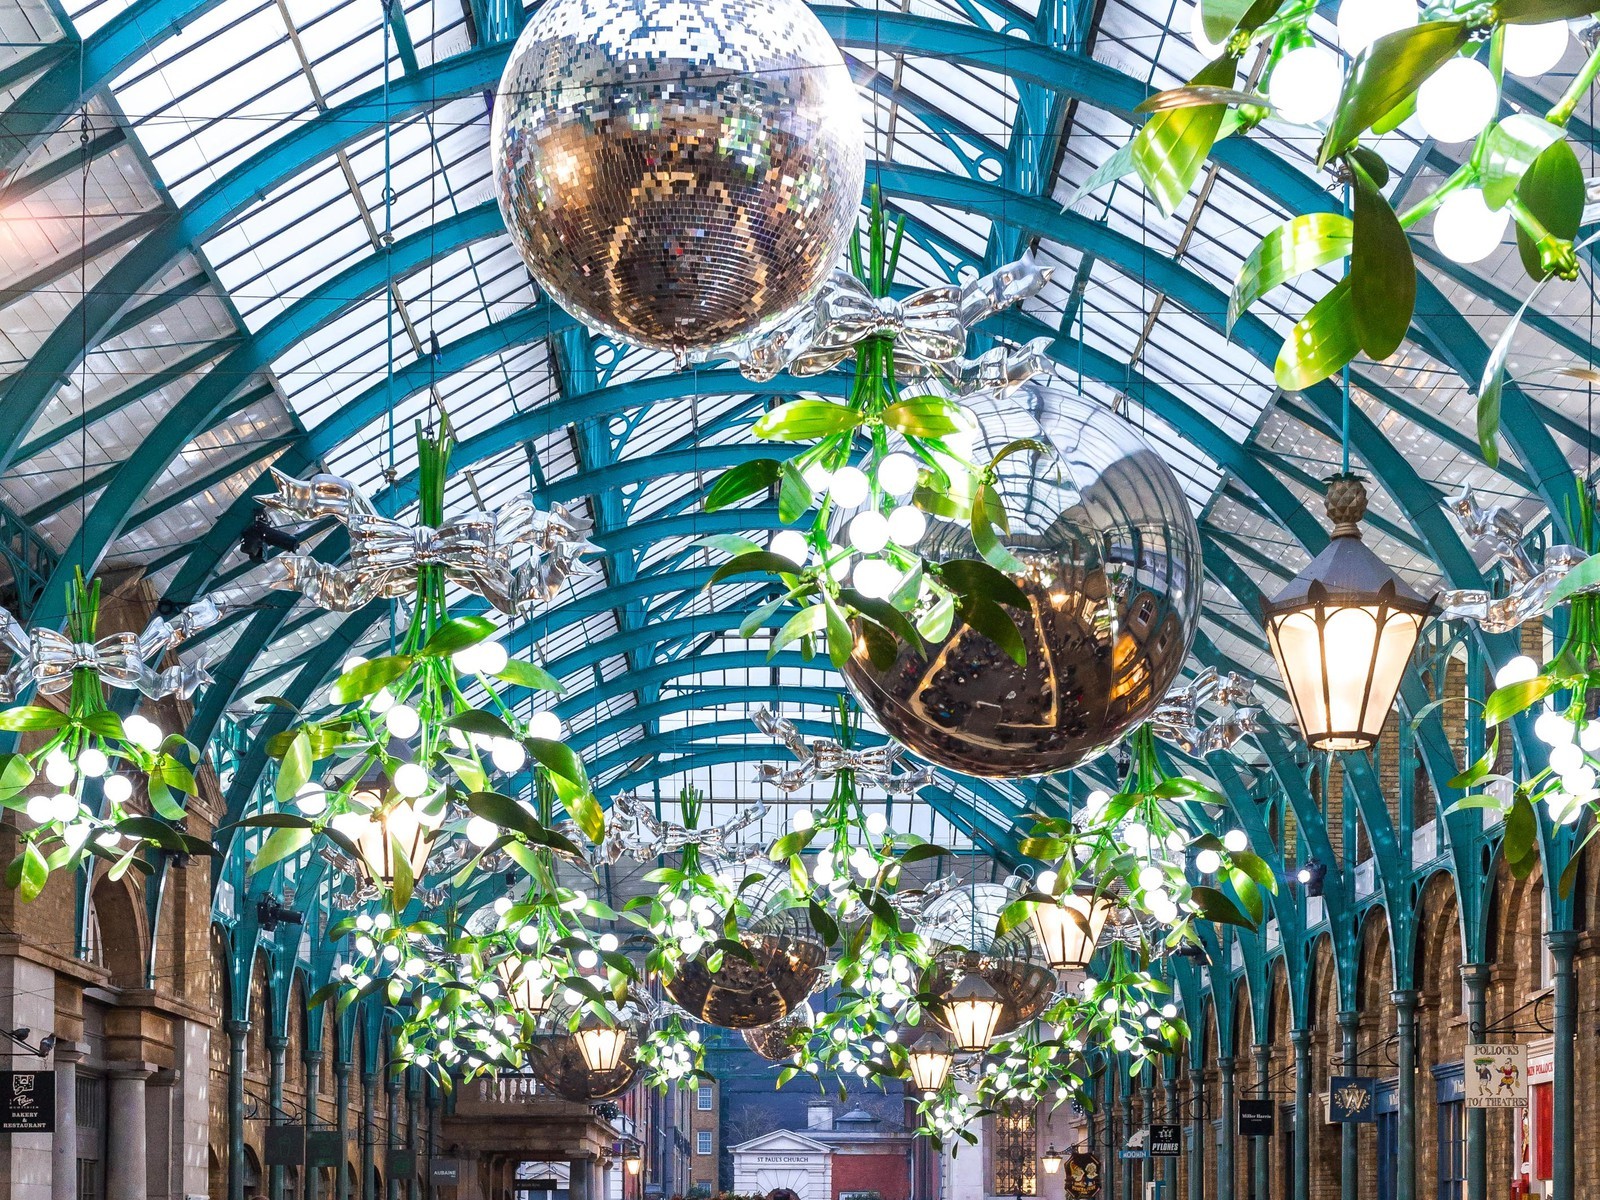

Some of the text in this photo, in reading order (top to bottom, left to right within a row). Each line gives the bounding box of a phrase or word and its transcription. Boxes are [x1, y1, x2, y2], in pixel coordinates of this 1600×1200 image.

[1467, 1097, 1528, 1107] TOY THEATRES
[1152, 1142, 1179, 1151] PYLONES
